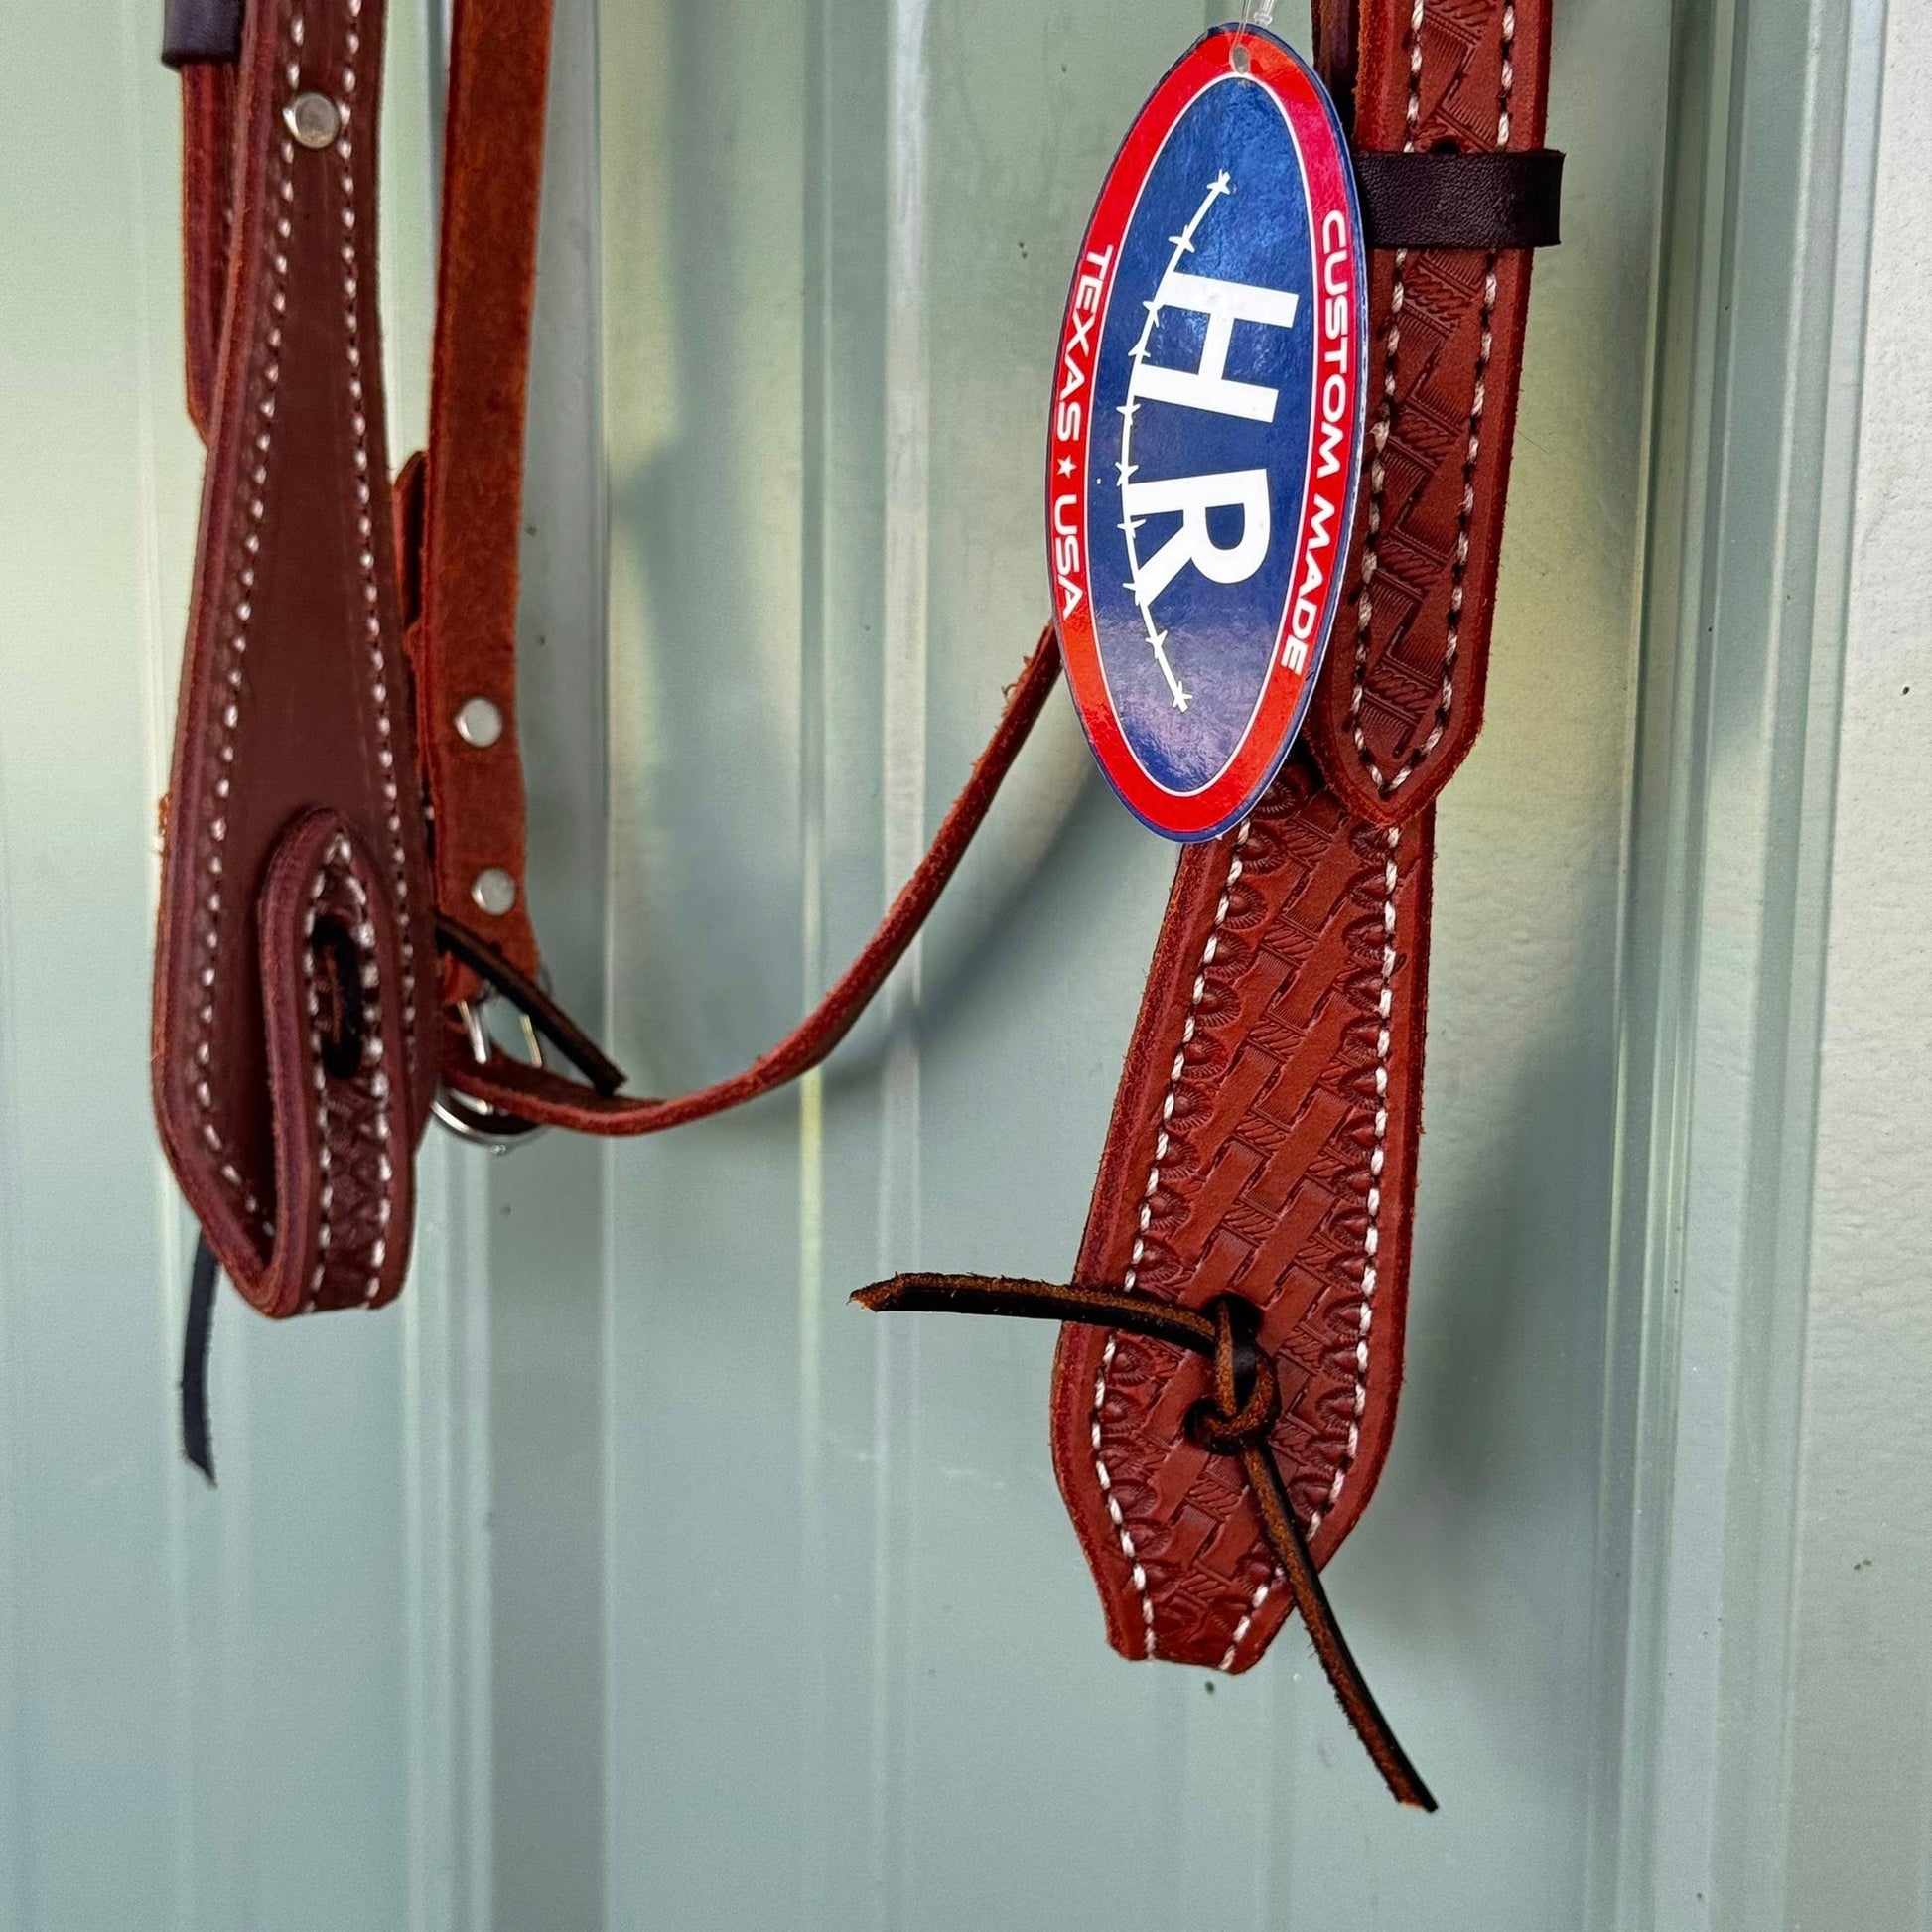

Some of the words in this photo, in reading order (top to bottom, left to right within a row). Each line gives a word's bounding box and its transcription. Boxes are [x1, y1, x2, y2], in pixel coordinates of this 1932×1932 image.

[1057, 244, 1114, 442] TEXAS
[1129, 272, 1299, 607] HR
[1317, 209, 1348, 480] CUSTOM
[1053, 494, 1084, 620] USA
[1281, 494, 1335, 676] MADE
